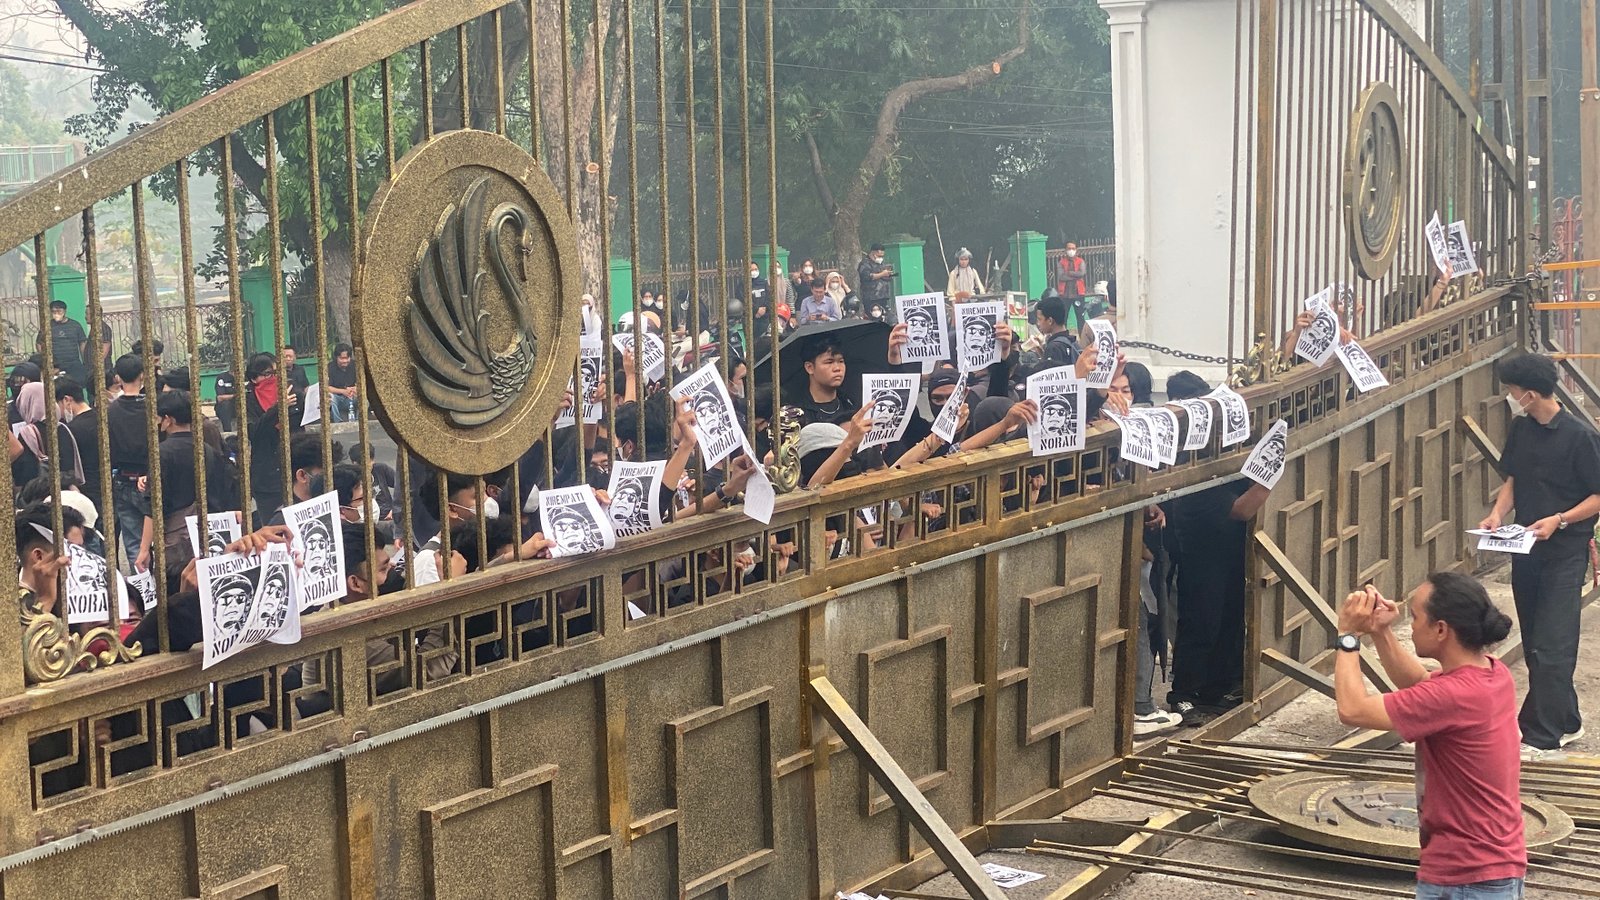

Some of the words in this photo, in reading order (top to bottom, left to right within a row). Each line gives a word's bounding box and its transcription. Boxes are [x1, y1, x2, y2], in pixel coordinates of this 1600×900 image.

[1452, 261, 1472, 273] ORAK
[907, 345, 942, 358] NORAK
[871, 378, 912, 389] NIREMPATI
[1040, 384, 1077, 394] NIREMPATI
[707, 430, 736, 460] NORAK
[863, 429, 897, 445] NORAK
[1040, 435, 1076, 450] NORAK
[1126, 442, 1153, 461] NORAK
[1246, 461, 1274, 482] NORAK
[294, 500, 332, 522] NIREMPATI
[208, 519, 230, 531] EMPATI
[616, 527, 652, 538] ORA
[208, 555, 261, 577] NIREMPATI
[304, 575, 339, 604] NORAK
[68, 593, 108, 614] NORA
